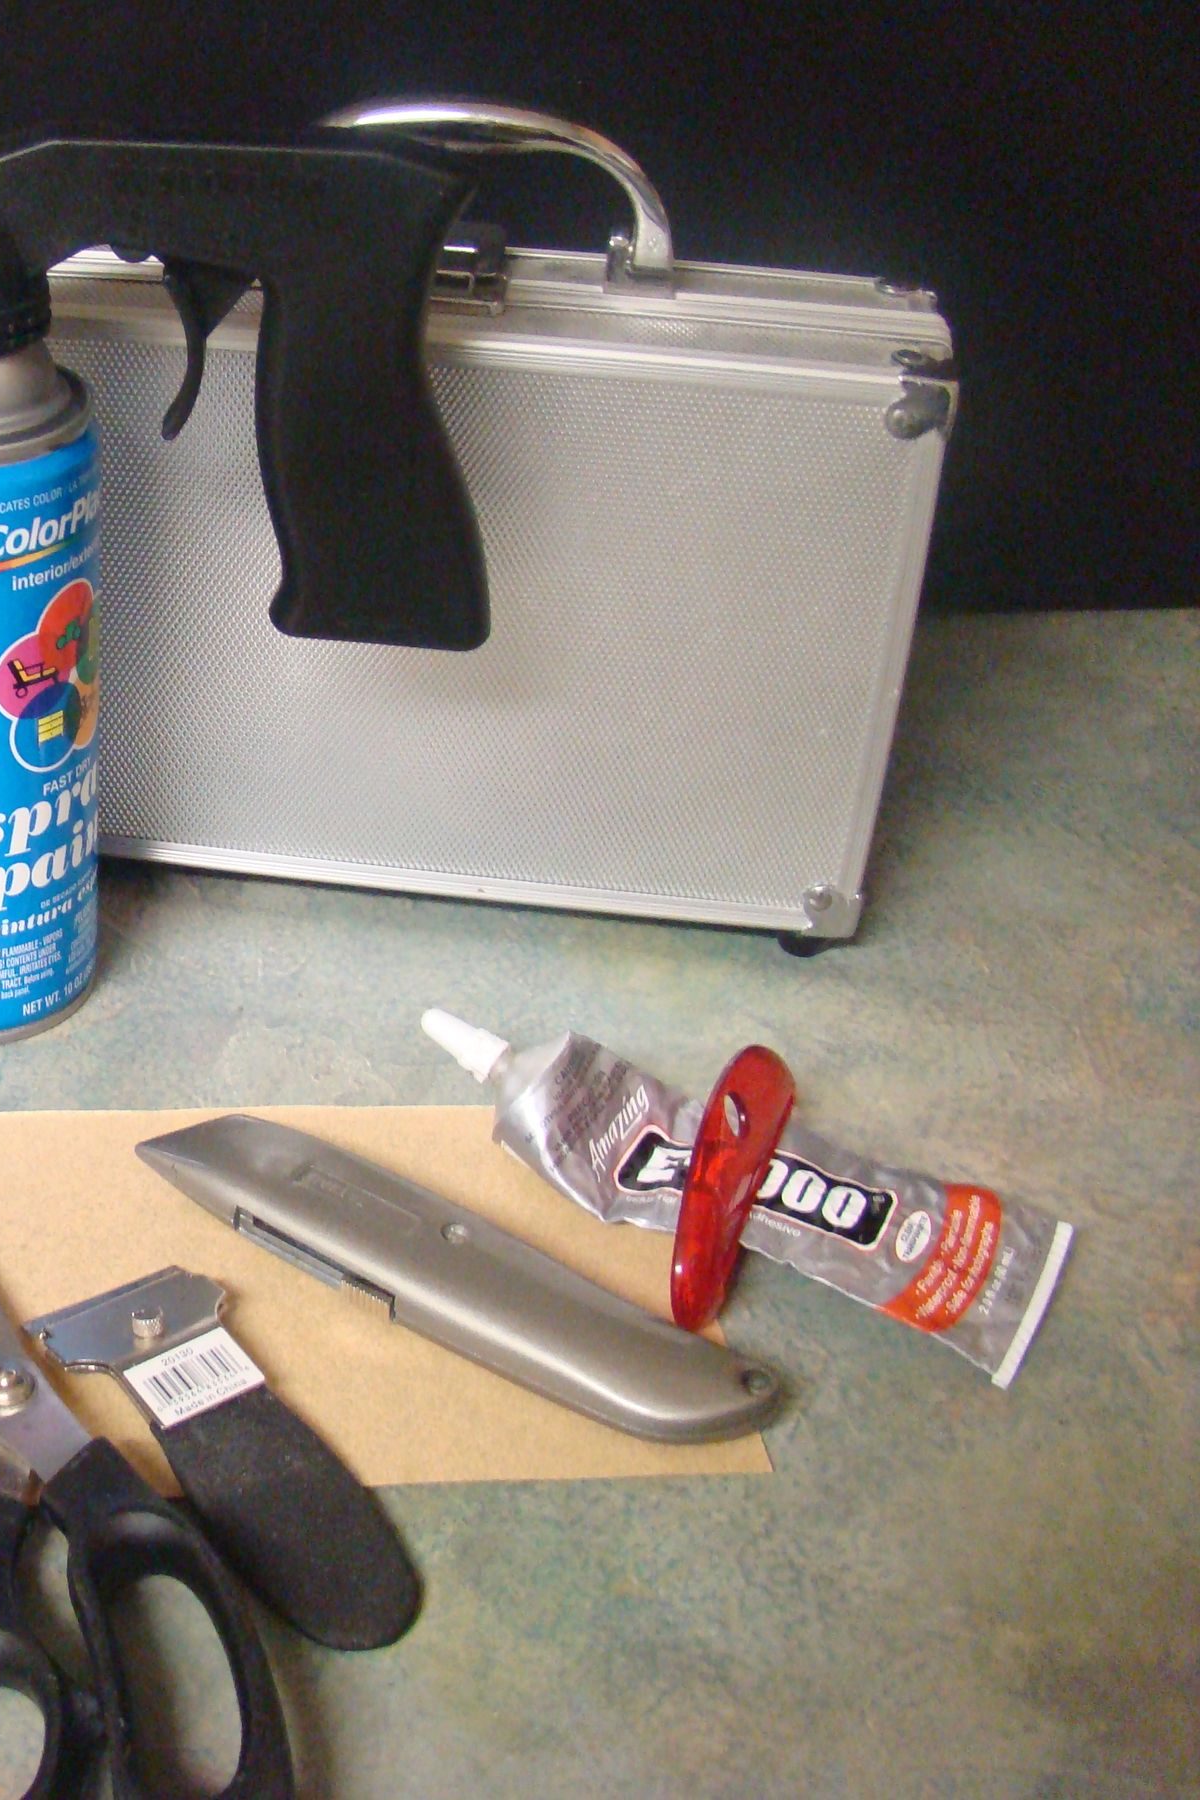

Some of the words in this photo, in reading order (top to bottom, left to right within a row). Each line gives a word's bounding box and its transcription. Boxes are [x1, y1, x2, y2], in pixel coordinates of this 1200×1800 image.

[32, 487, 63, 507] COLOR
[42, 769, 74, 797] FAST
[1, 939, 39, 958] FLAMMABLE
[43, 928, 63, 946] VAPORS
[6, 950, 38, 968] CONTENTS
[38, 942, 57, 959] UNDER
[19, 957, 48, 976] IRRITATES
[22, 999, 43, 1017] NET
[44, 990, 61, 1008] WT.
[64, 981, 74, 997] 10
[588, 1083, 650, 1184] Amazing
[174, 1399, 204, 1416] Made
[216, 1378, 248, 1396] China
